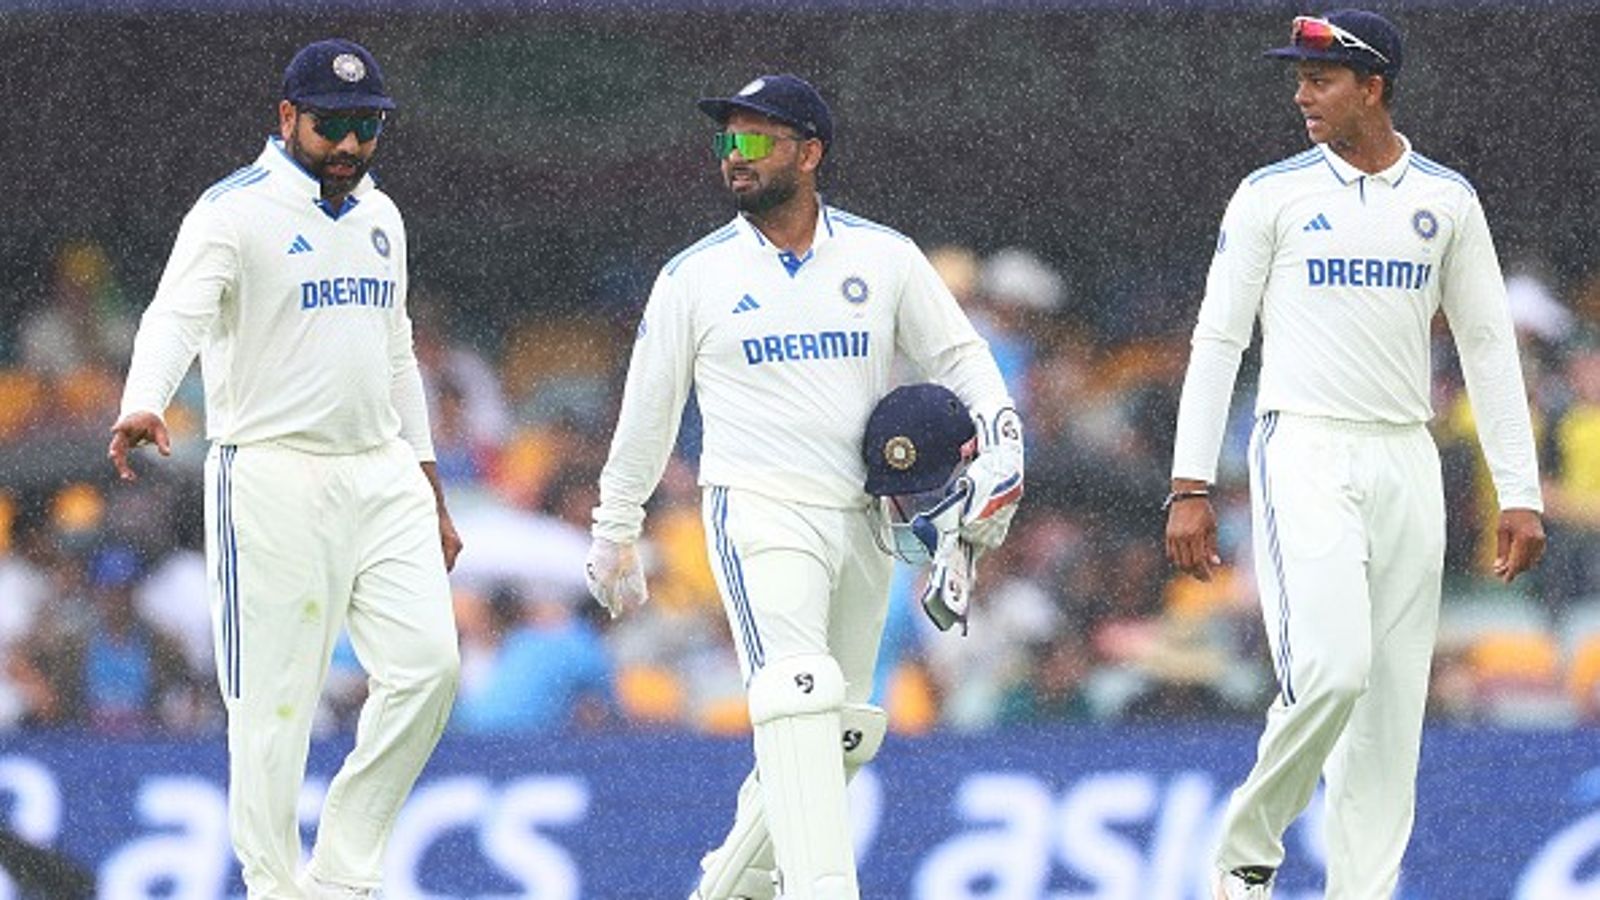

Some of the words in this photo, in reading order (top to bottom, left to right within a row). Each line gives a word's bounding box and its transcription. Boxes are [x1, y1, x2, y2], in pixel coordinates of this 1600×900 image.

[301, 277, 396, 310] DREAM11
[742, 330, 869, 365] DREAM11
[100, 773, 590, 900] acs
